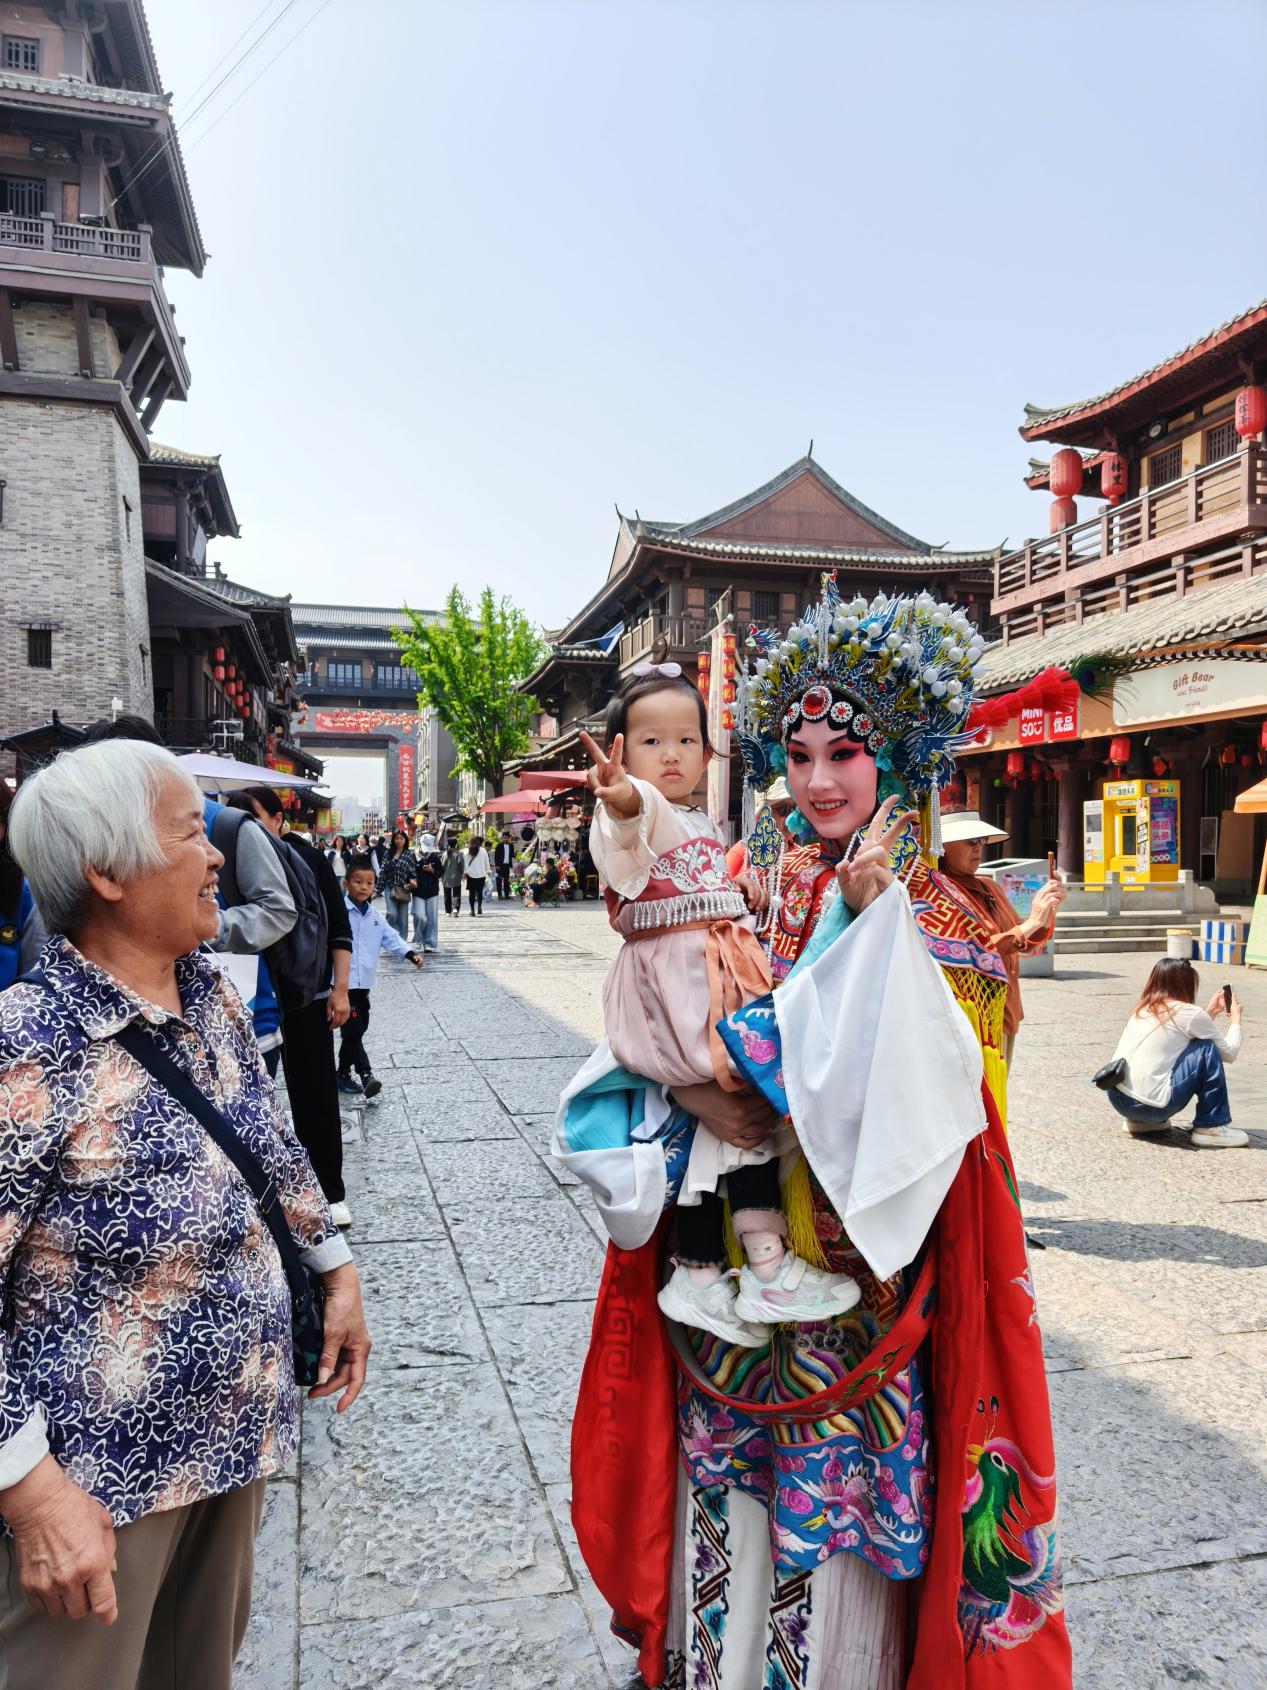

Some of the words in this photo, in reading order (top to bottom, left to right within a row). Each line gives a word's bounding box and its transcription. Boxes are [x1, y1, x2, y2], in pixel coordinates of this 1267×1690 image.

[1173, 673, 1189, 690] Gift
[1191, 671, 1214, 683] Bear
[1022, 708, 1043, 720] MINI
[1054, 715, 1074, 733] 优品
